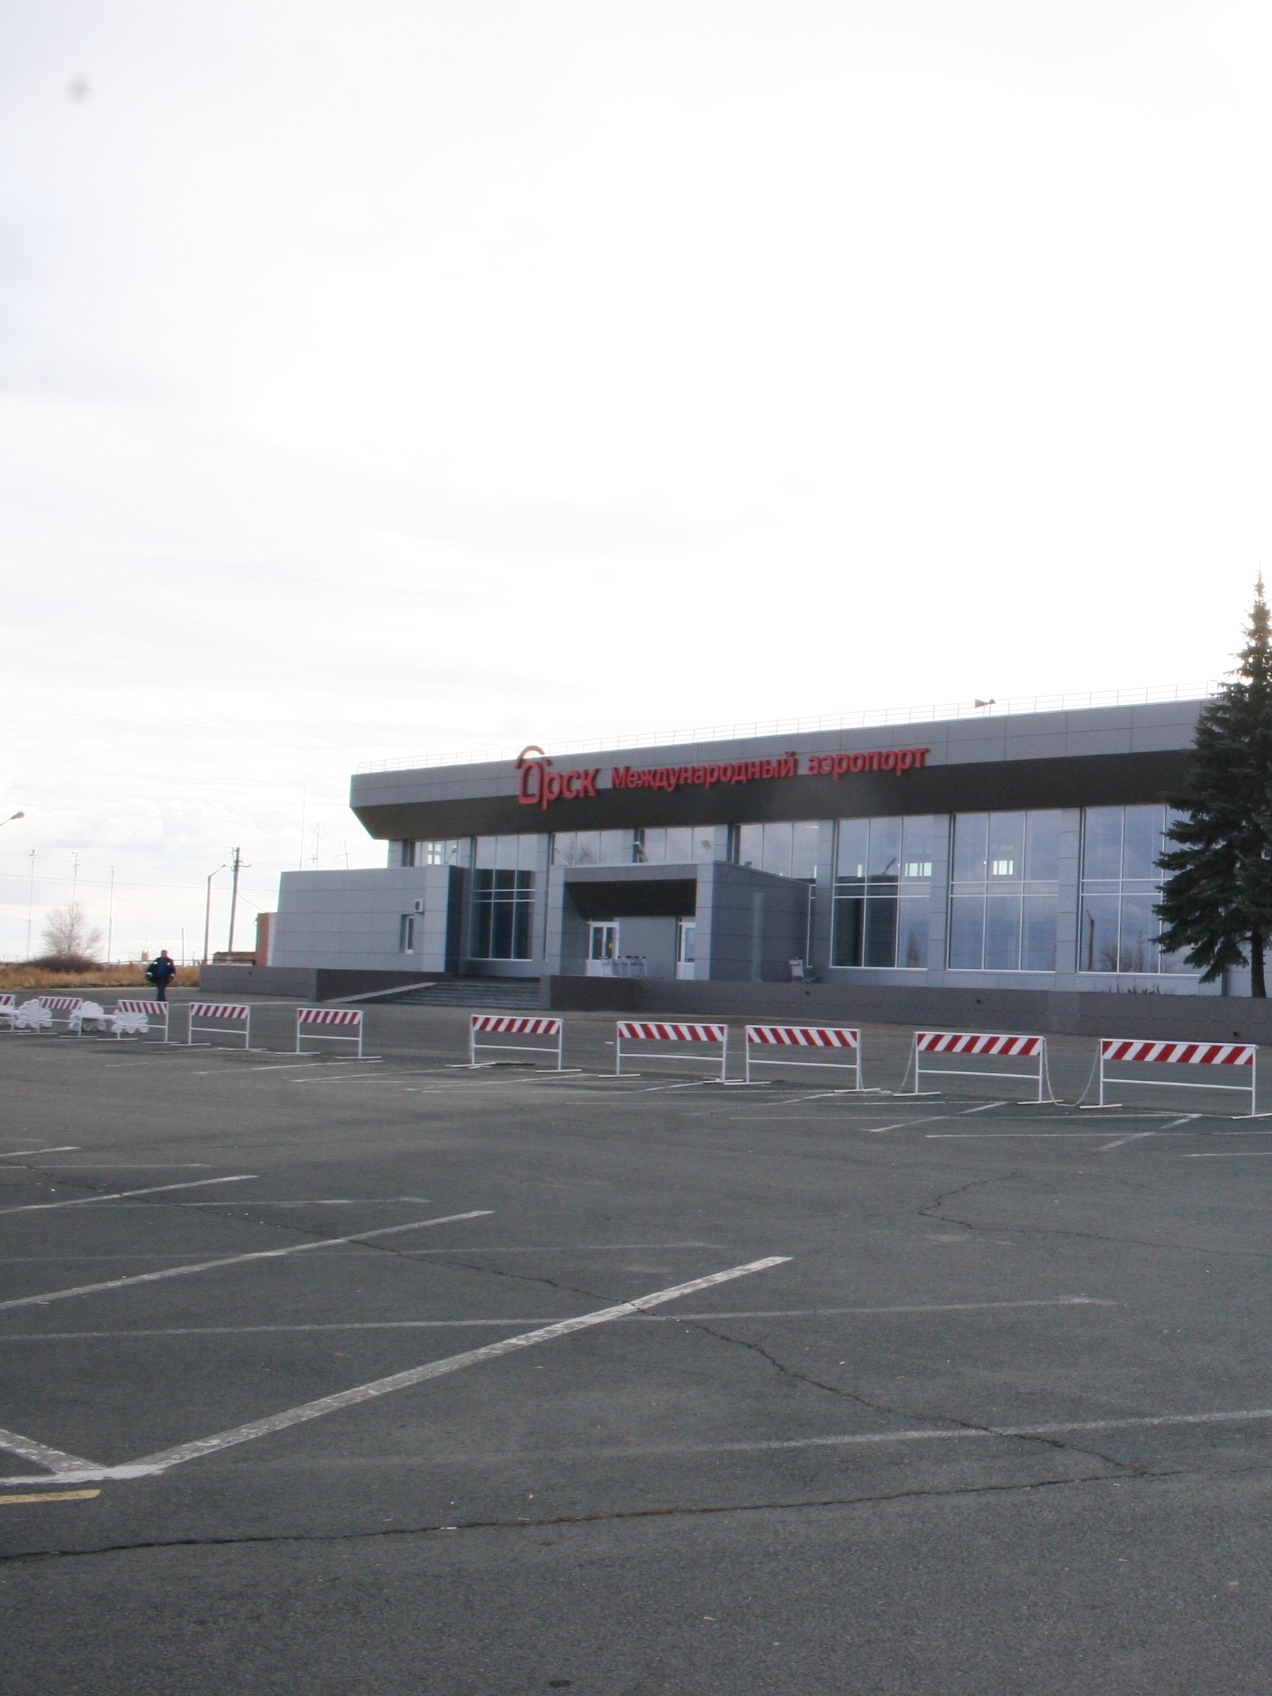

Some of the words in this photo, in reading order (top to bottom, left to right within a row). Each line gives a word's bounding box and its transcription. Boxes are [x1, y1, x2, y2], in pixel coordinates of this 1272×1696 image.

[515, 746, 599, 810] Орск
[611, 751, 798, 792] Международный
[807, 748, 929, 780] аэропорт
